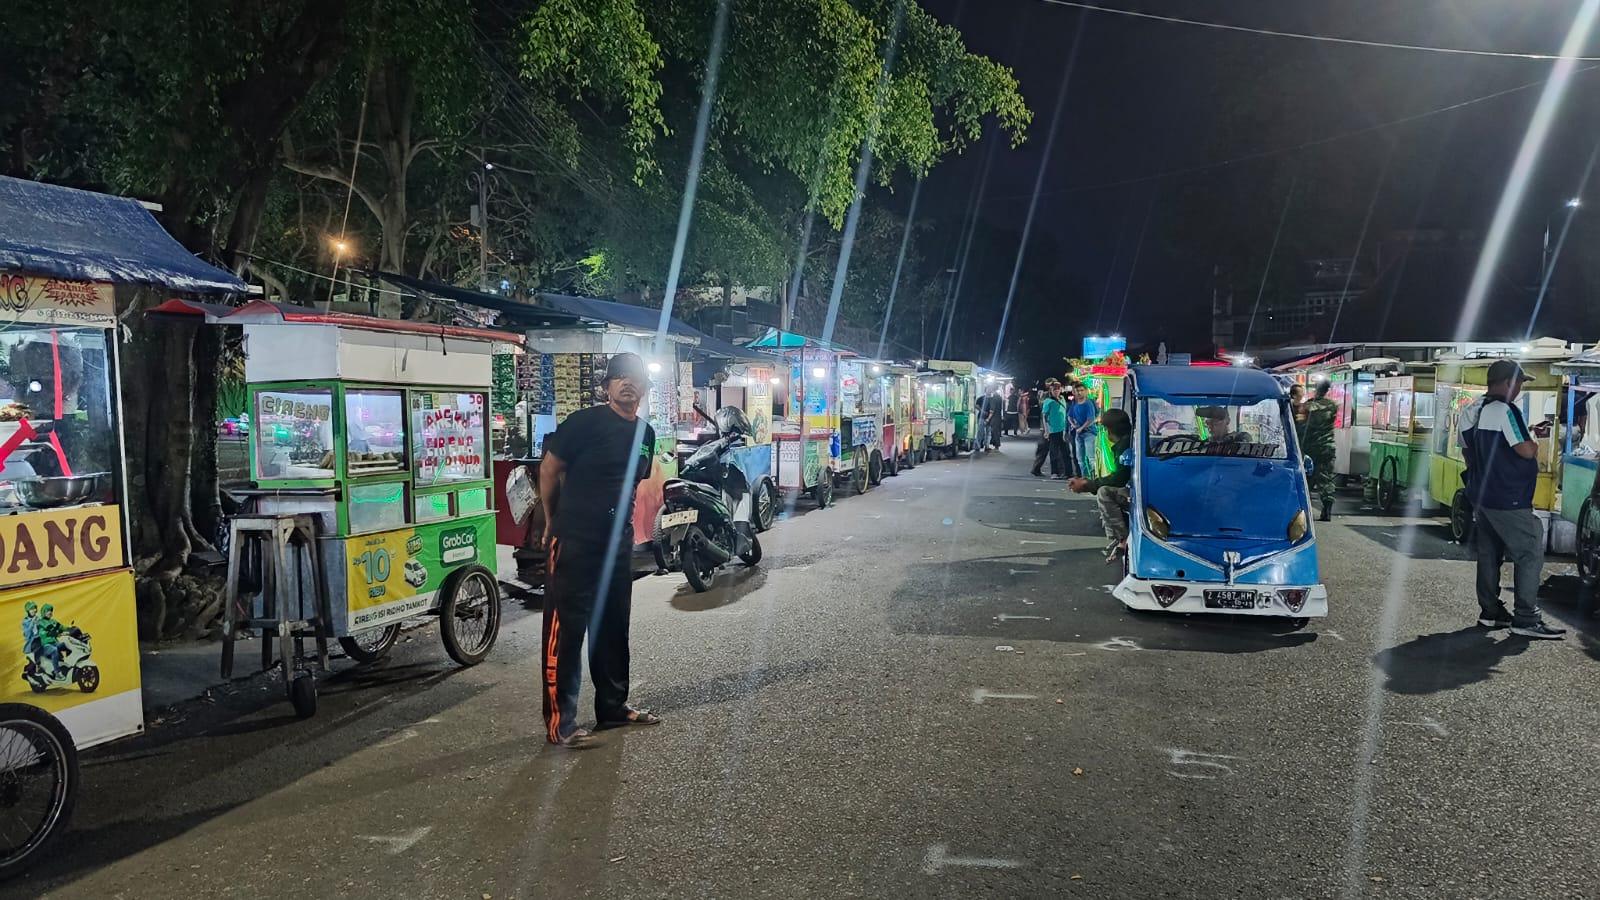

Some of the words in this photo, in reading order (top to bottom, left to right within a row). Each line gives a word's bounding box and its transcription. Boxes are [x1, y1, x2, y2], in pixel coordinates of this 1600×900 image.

[262, 395, 330, 421] CIRENG
[0, 515, 111, 574] ANG
[442, 533, 474, 548] GrabCar
[361, 548, 390, 584] 10
